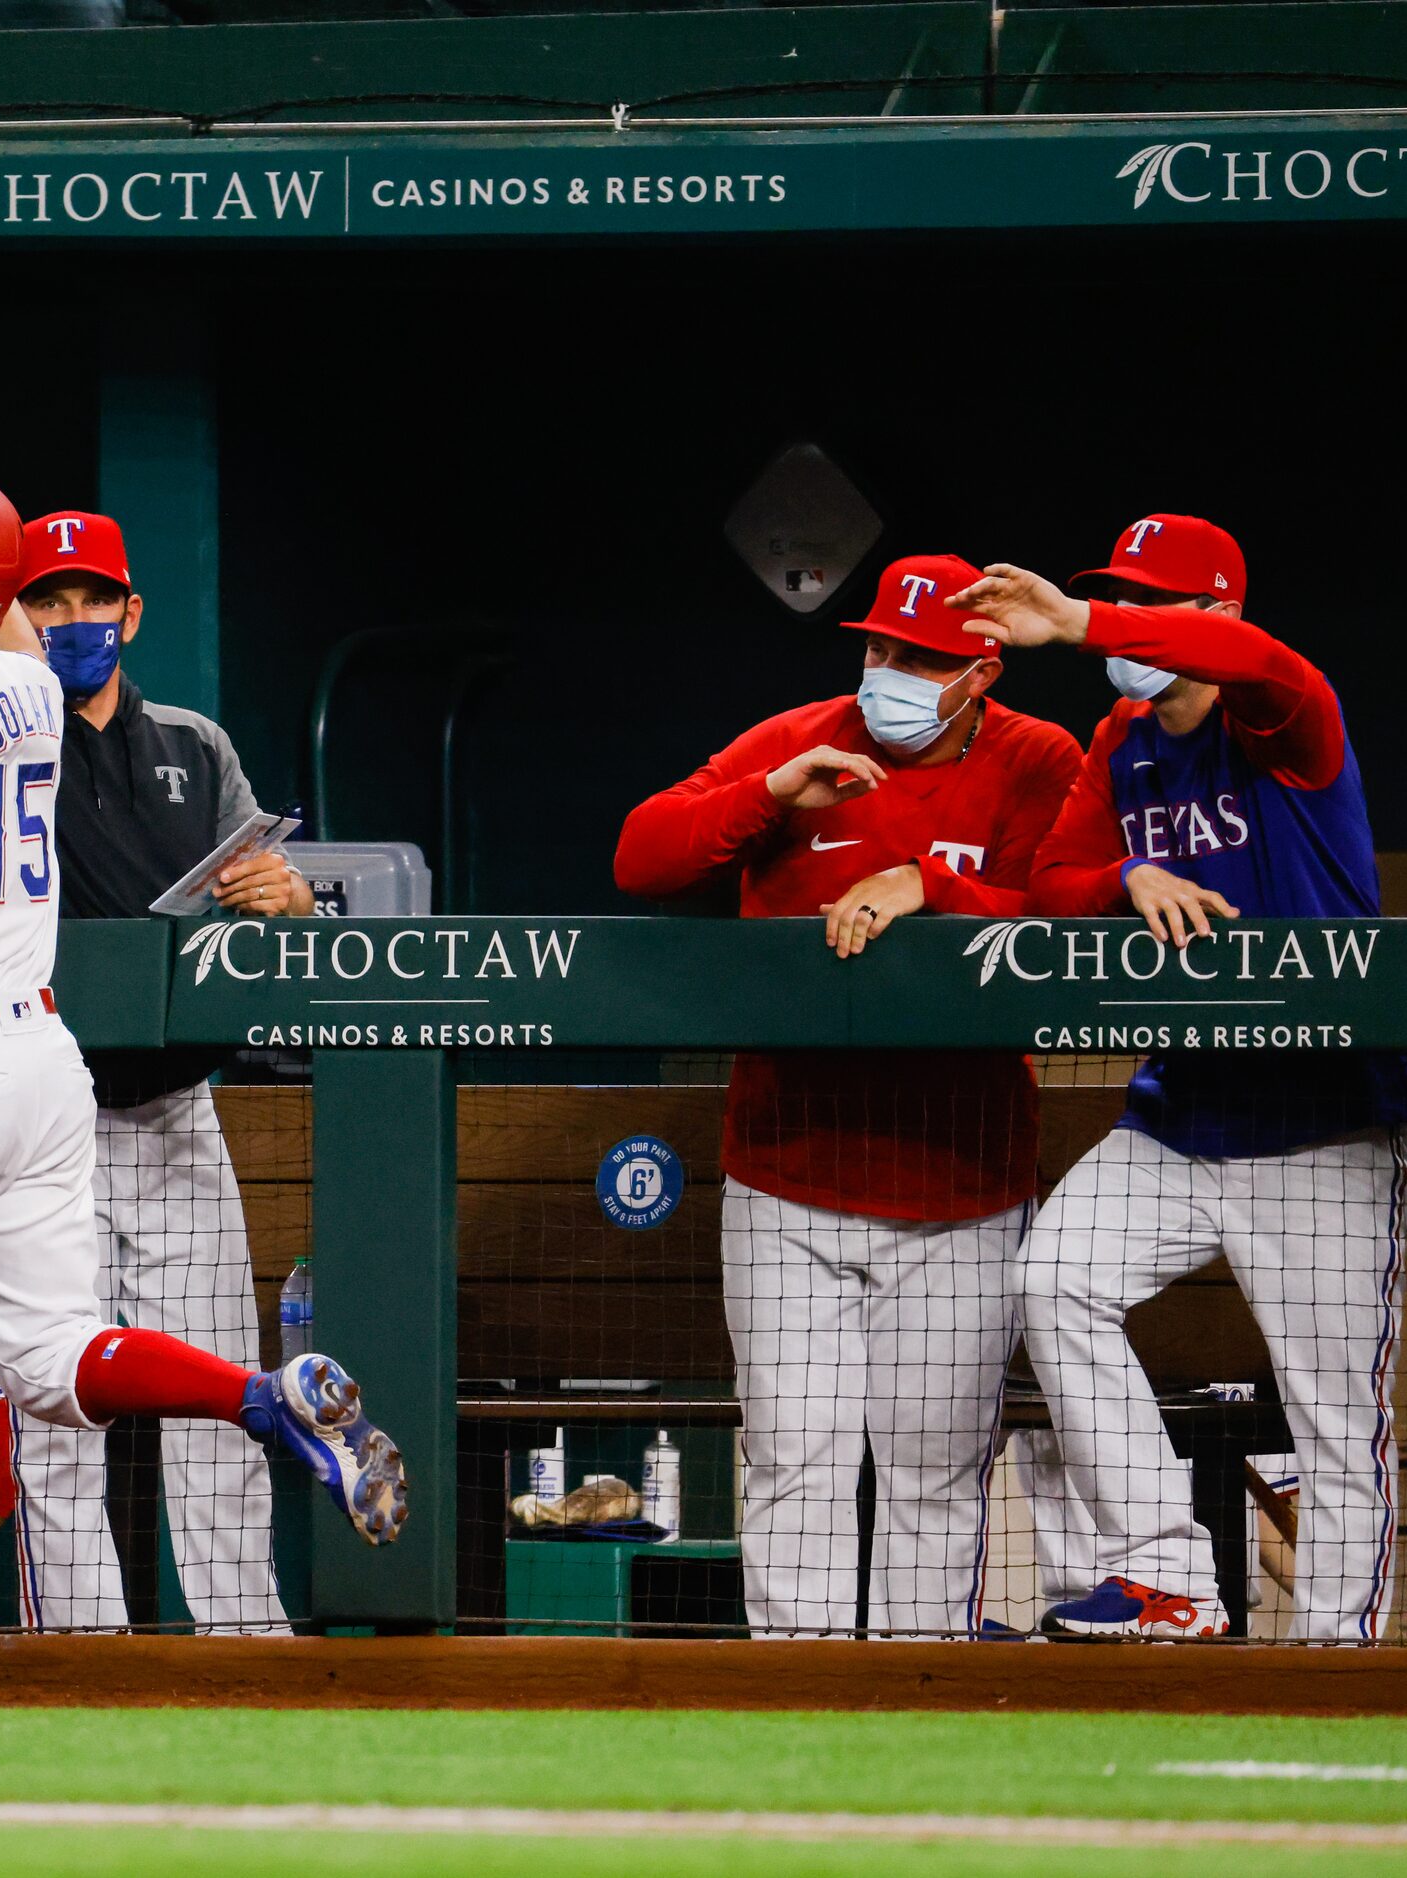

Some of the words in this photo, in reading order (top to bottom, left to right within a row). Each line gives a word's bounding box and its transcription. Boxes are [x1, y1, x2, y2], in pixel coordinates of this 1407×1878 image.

[371, 177, 551, 207] CASINOS
[567, 177, 590, 205] &
[606, 175, 787, 204] RESORTS
[47, 518, 86, 554] T
[1125, 519, 1164, 556] T
[898, 574, 938, 618] T
[154, 765, 189, 804] T
[928, 840, 988, 877] T
[219, 920, 581, 981] CHOCTAW
[1004, 920, 1381, 981] CHOCTAW
[246, 1025, 379, 1046] CASINOS
[391, 1025, 409, 1046] &
[419, 1024, 553, 1046] RESORTS
[1034, 1026, 1171, 1048] CASINOS
[1183, 1026, 1202, 1048] &
[1213, 1025, 1353, 1048] RESORTS
[612, 1149, 626, 1164] DO
[604, 1195, 621, 1216] STAY
[619, 1212, 626, 1222] 6
[627, 1214, 648, 1225] FEET
[649, 1195, 673, 1221] APART
